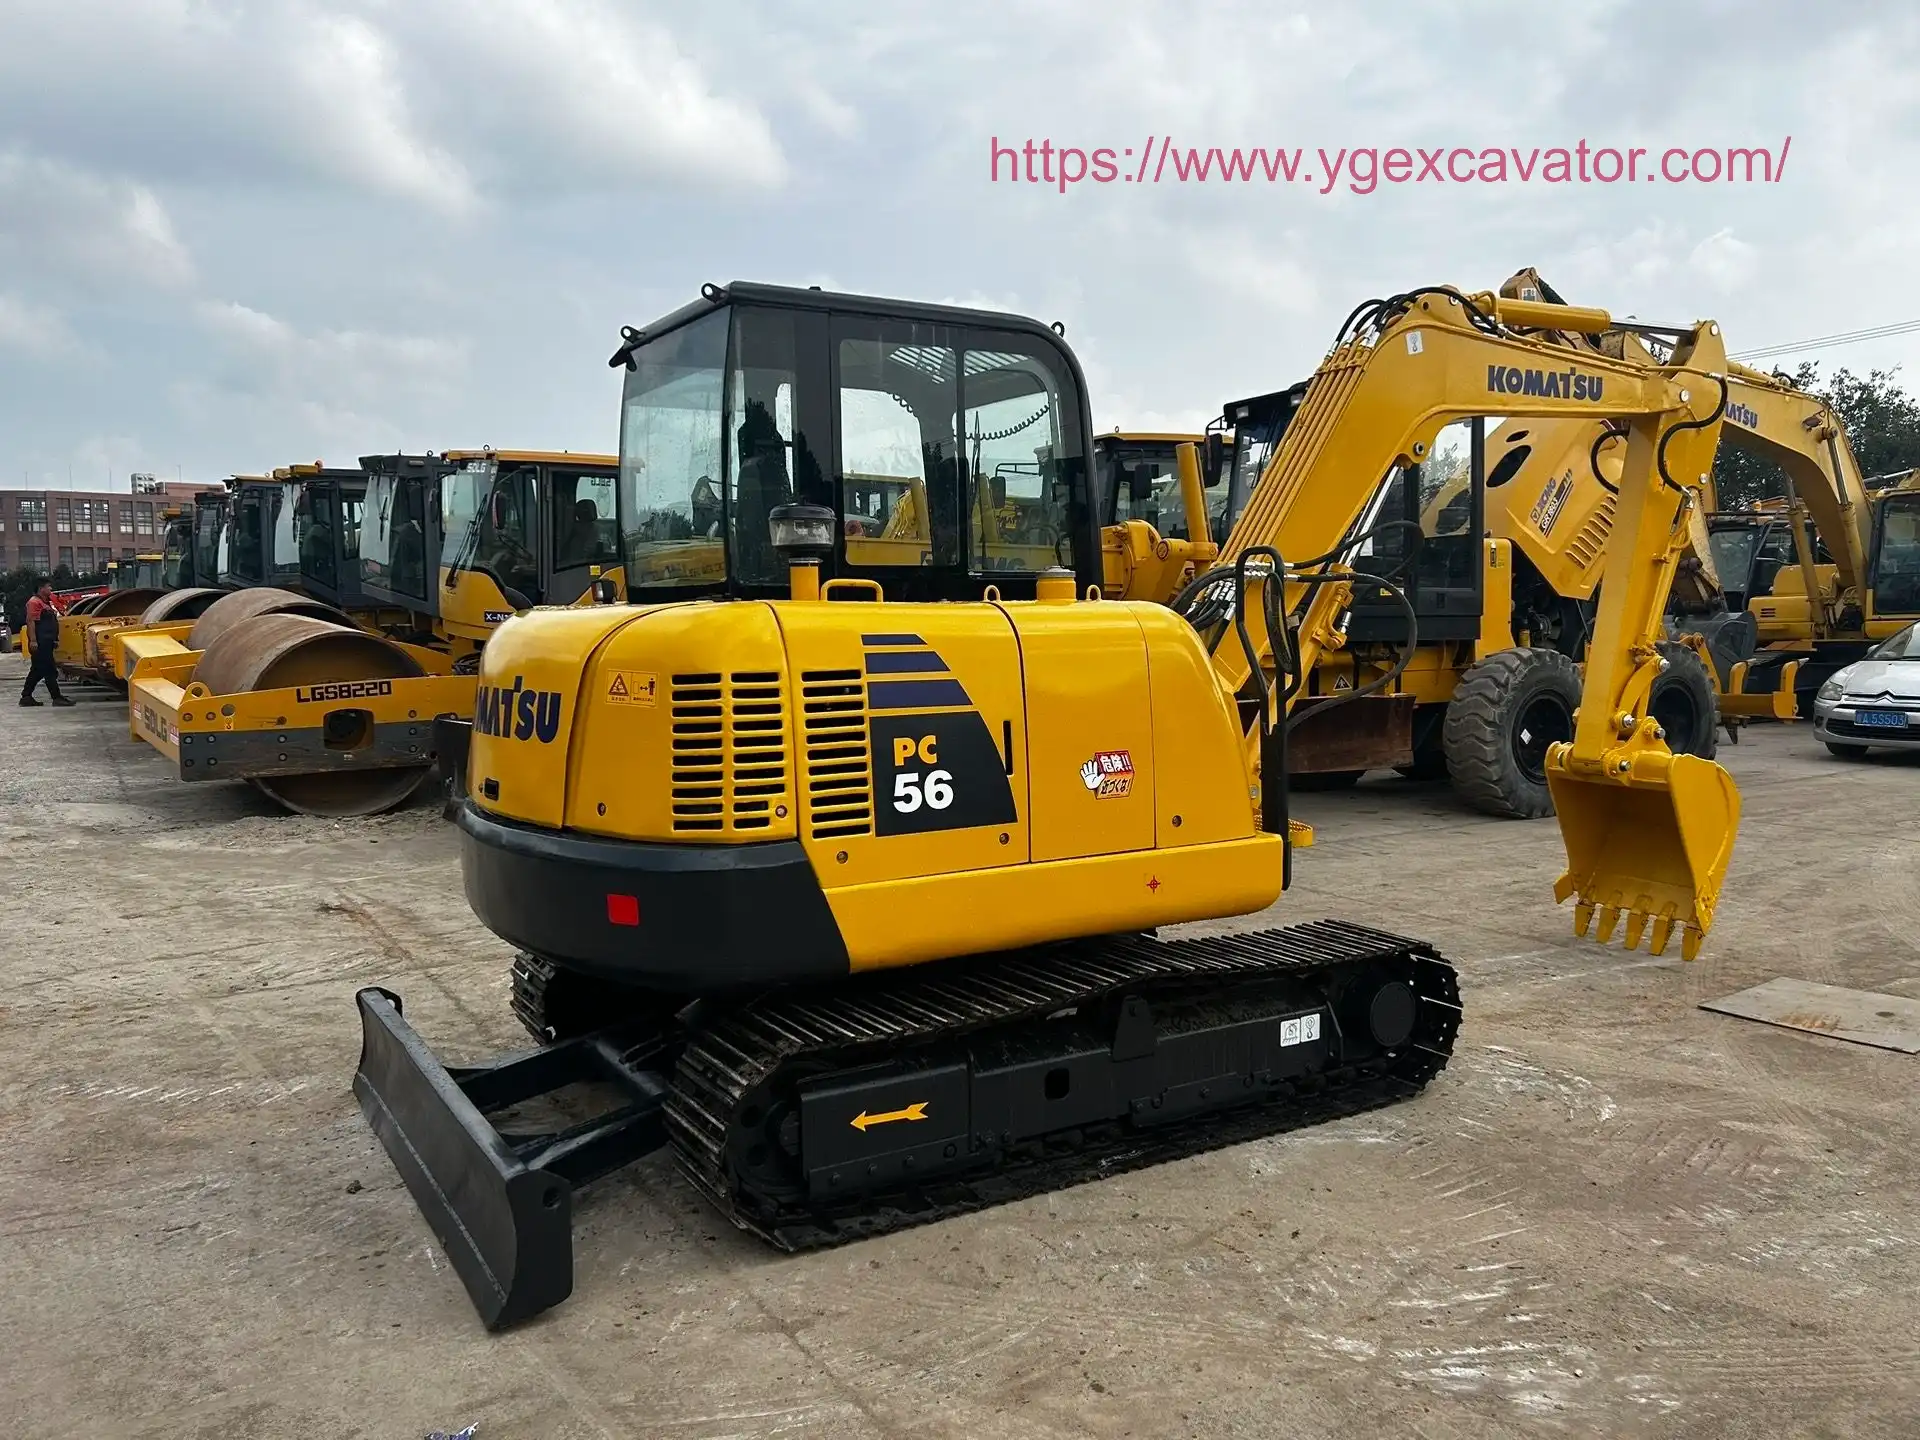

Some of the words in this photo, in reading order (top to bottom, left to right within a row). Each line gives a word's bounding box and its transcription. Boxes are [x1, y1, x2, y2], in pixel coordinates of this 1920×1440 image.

[1487, 365, 1603, 402] KOMATSU
[296, 680, 393, 704] LGS8220
[144, 704, 169, 743] SDLG
[893, 734, 938, 767] PC
[893, 769, 954, 814] 56
